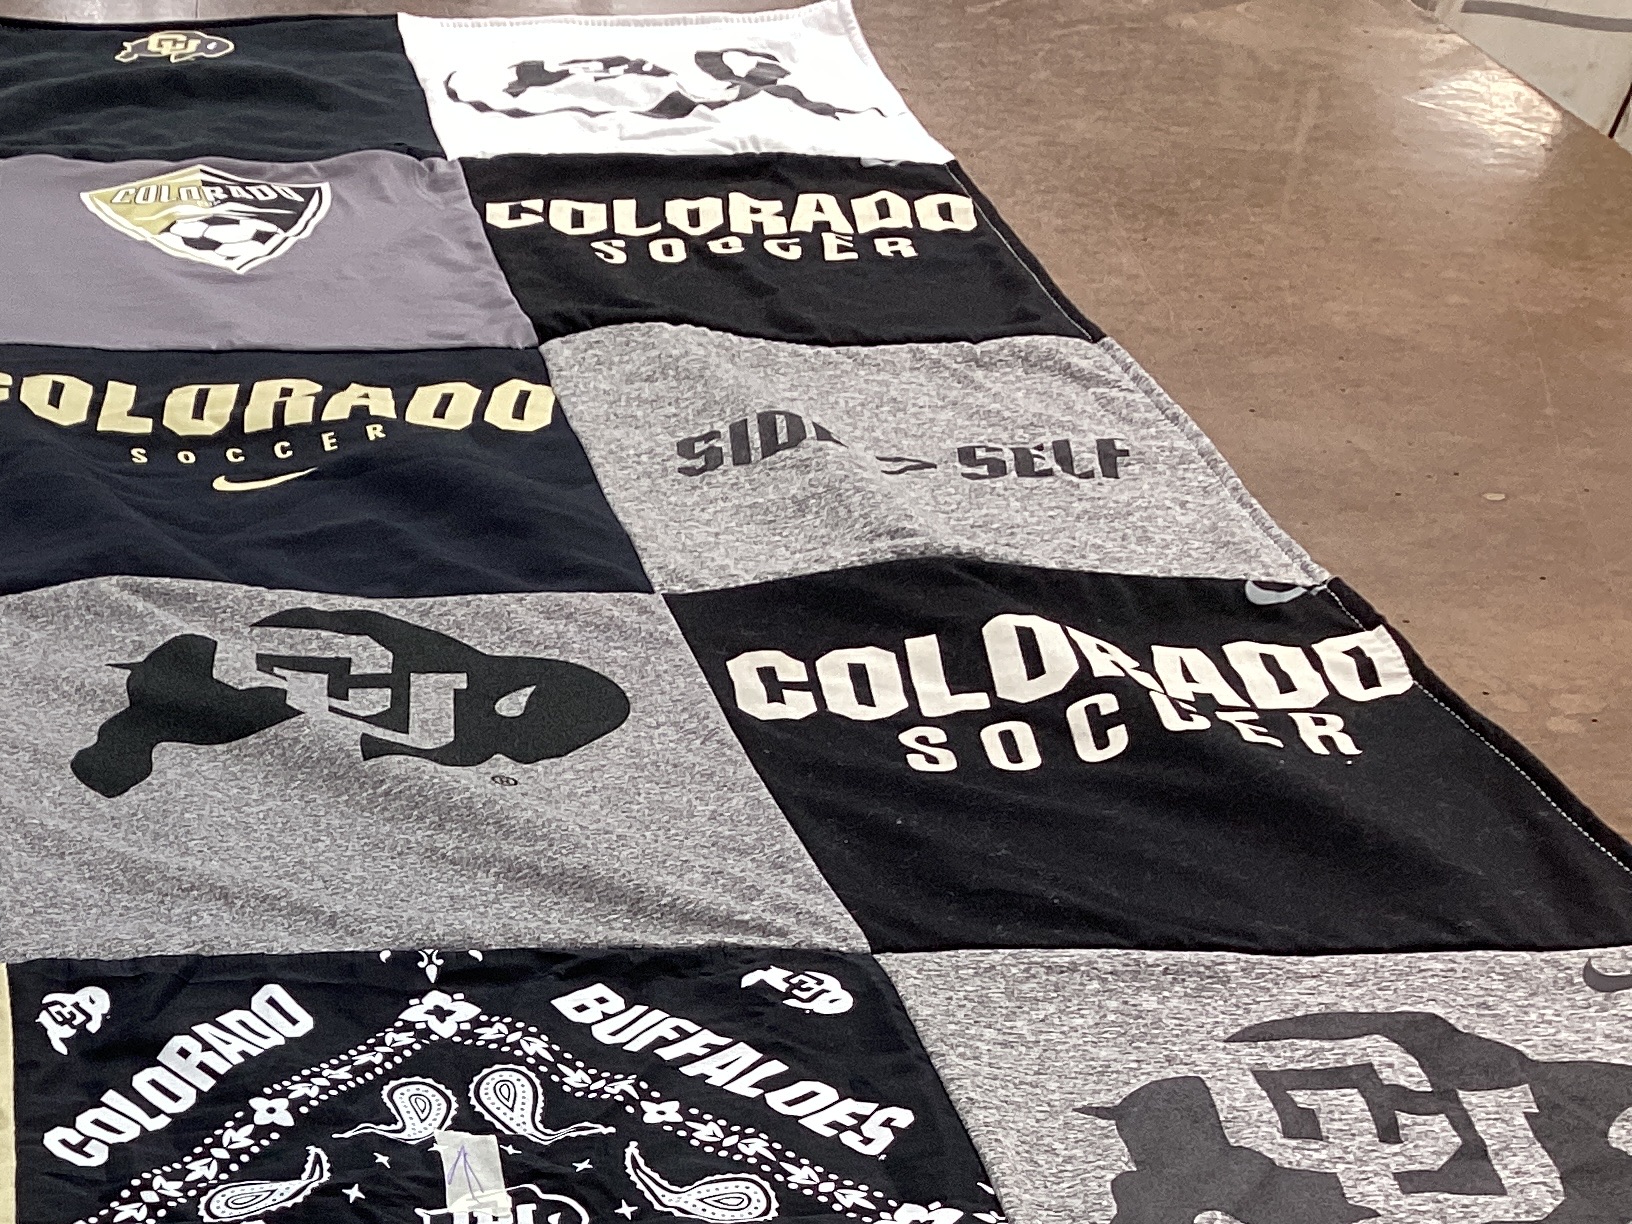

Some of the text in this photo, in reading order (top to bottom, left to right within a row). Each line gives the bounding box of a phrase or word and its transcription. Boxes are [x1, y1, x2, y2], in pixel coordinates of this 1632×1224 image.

[110, 184, 305, 206] COLORADO
[485, 190, 979, 236] COLORADO
[589, 231, 919, 265] SOCCER
[130, 423, 387, 466] SOCCER
[956, 437, 1131, 480] SELF
[726, 613, 1415, 721] COLORADO
[898, 692, 1363, 772] SOCCER
[42, 983, 314, 1167] COLORADO
[550, 982, 916, 1157] BUFFALOES
